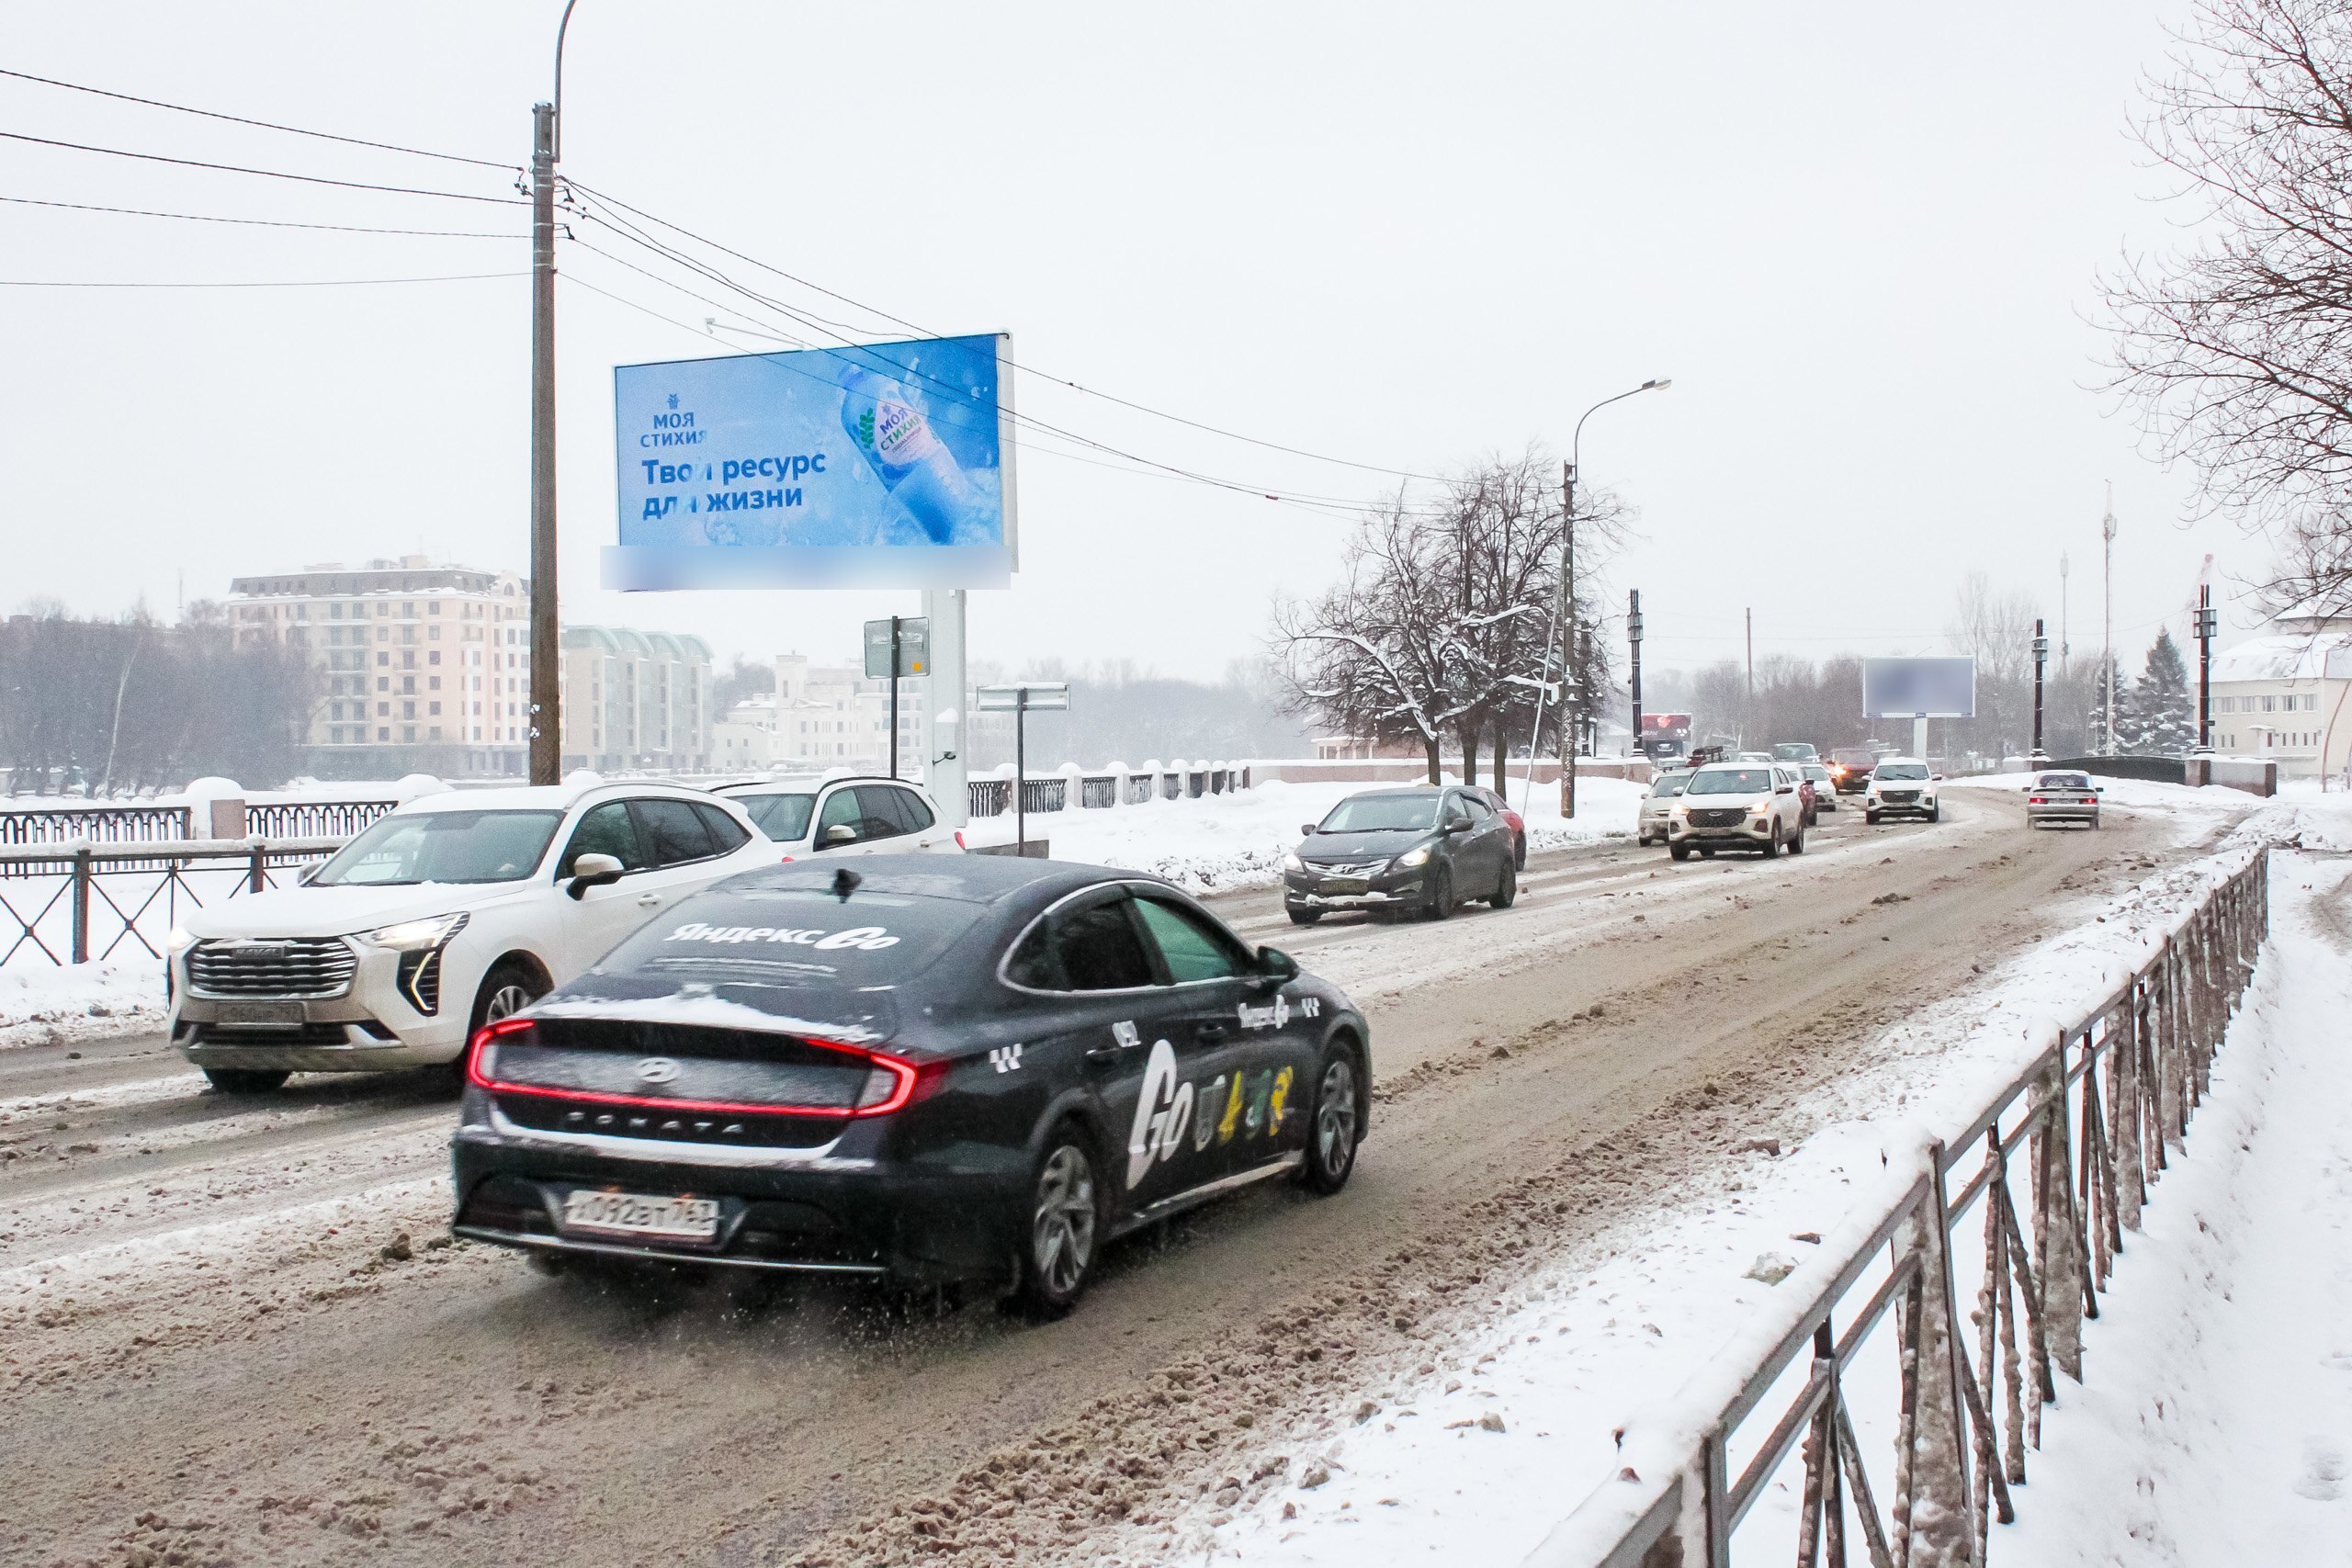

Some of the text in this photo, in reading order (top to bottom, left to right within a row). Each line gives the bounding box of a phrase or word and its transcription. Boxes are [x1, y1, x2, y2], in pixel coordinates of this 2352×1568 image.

[653, 412, 695, 429] МОЯ
[879, 408, 908, 434] МОЯ
[639, 430, 707, 447] СТИХИЯ
[722, 453, 827, 486] ресурс
[707, 488, 803, 513] жизни
[663, 922, 900, 950] Яндекс Go
[1125, 1039, 1194, 1190] Go
